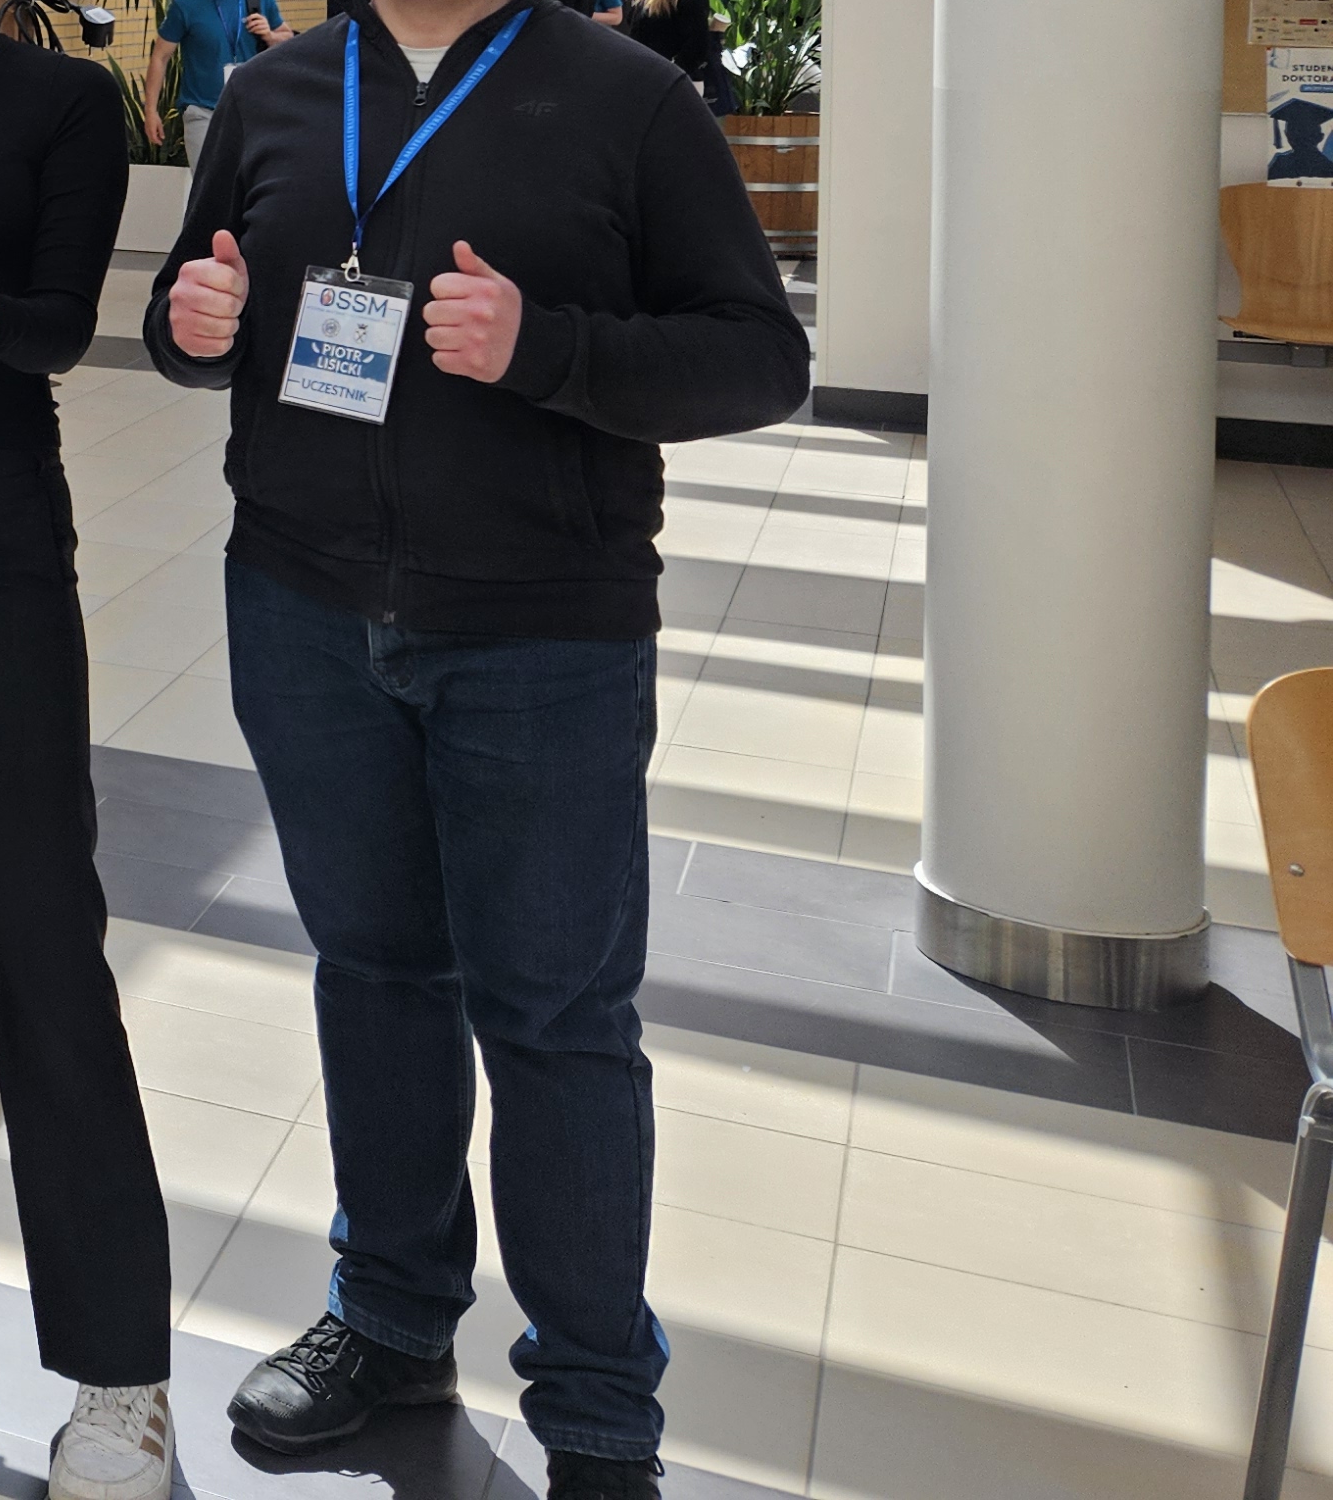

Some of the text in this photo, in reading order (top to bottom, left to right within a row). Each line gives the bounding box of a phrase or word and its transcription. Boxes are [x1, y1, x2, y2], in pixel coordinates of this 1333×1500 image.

[320, 287, 388, 317] OSSM
[323, 344, 362, 362] PIOTR
[317, 356, 361, 375] LISICKI
[301, 378, 367, 402] UCZESTNIK
